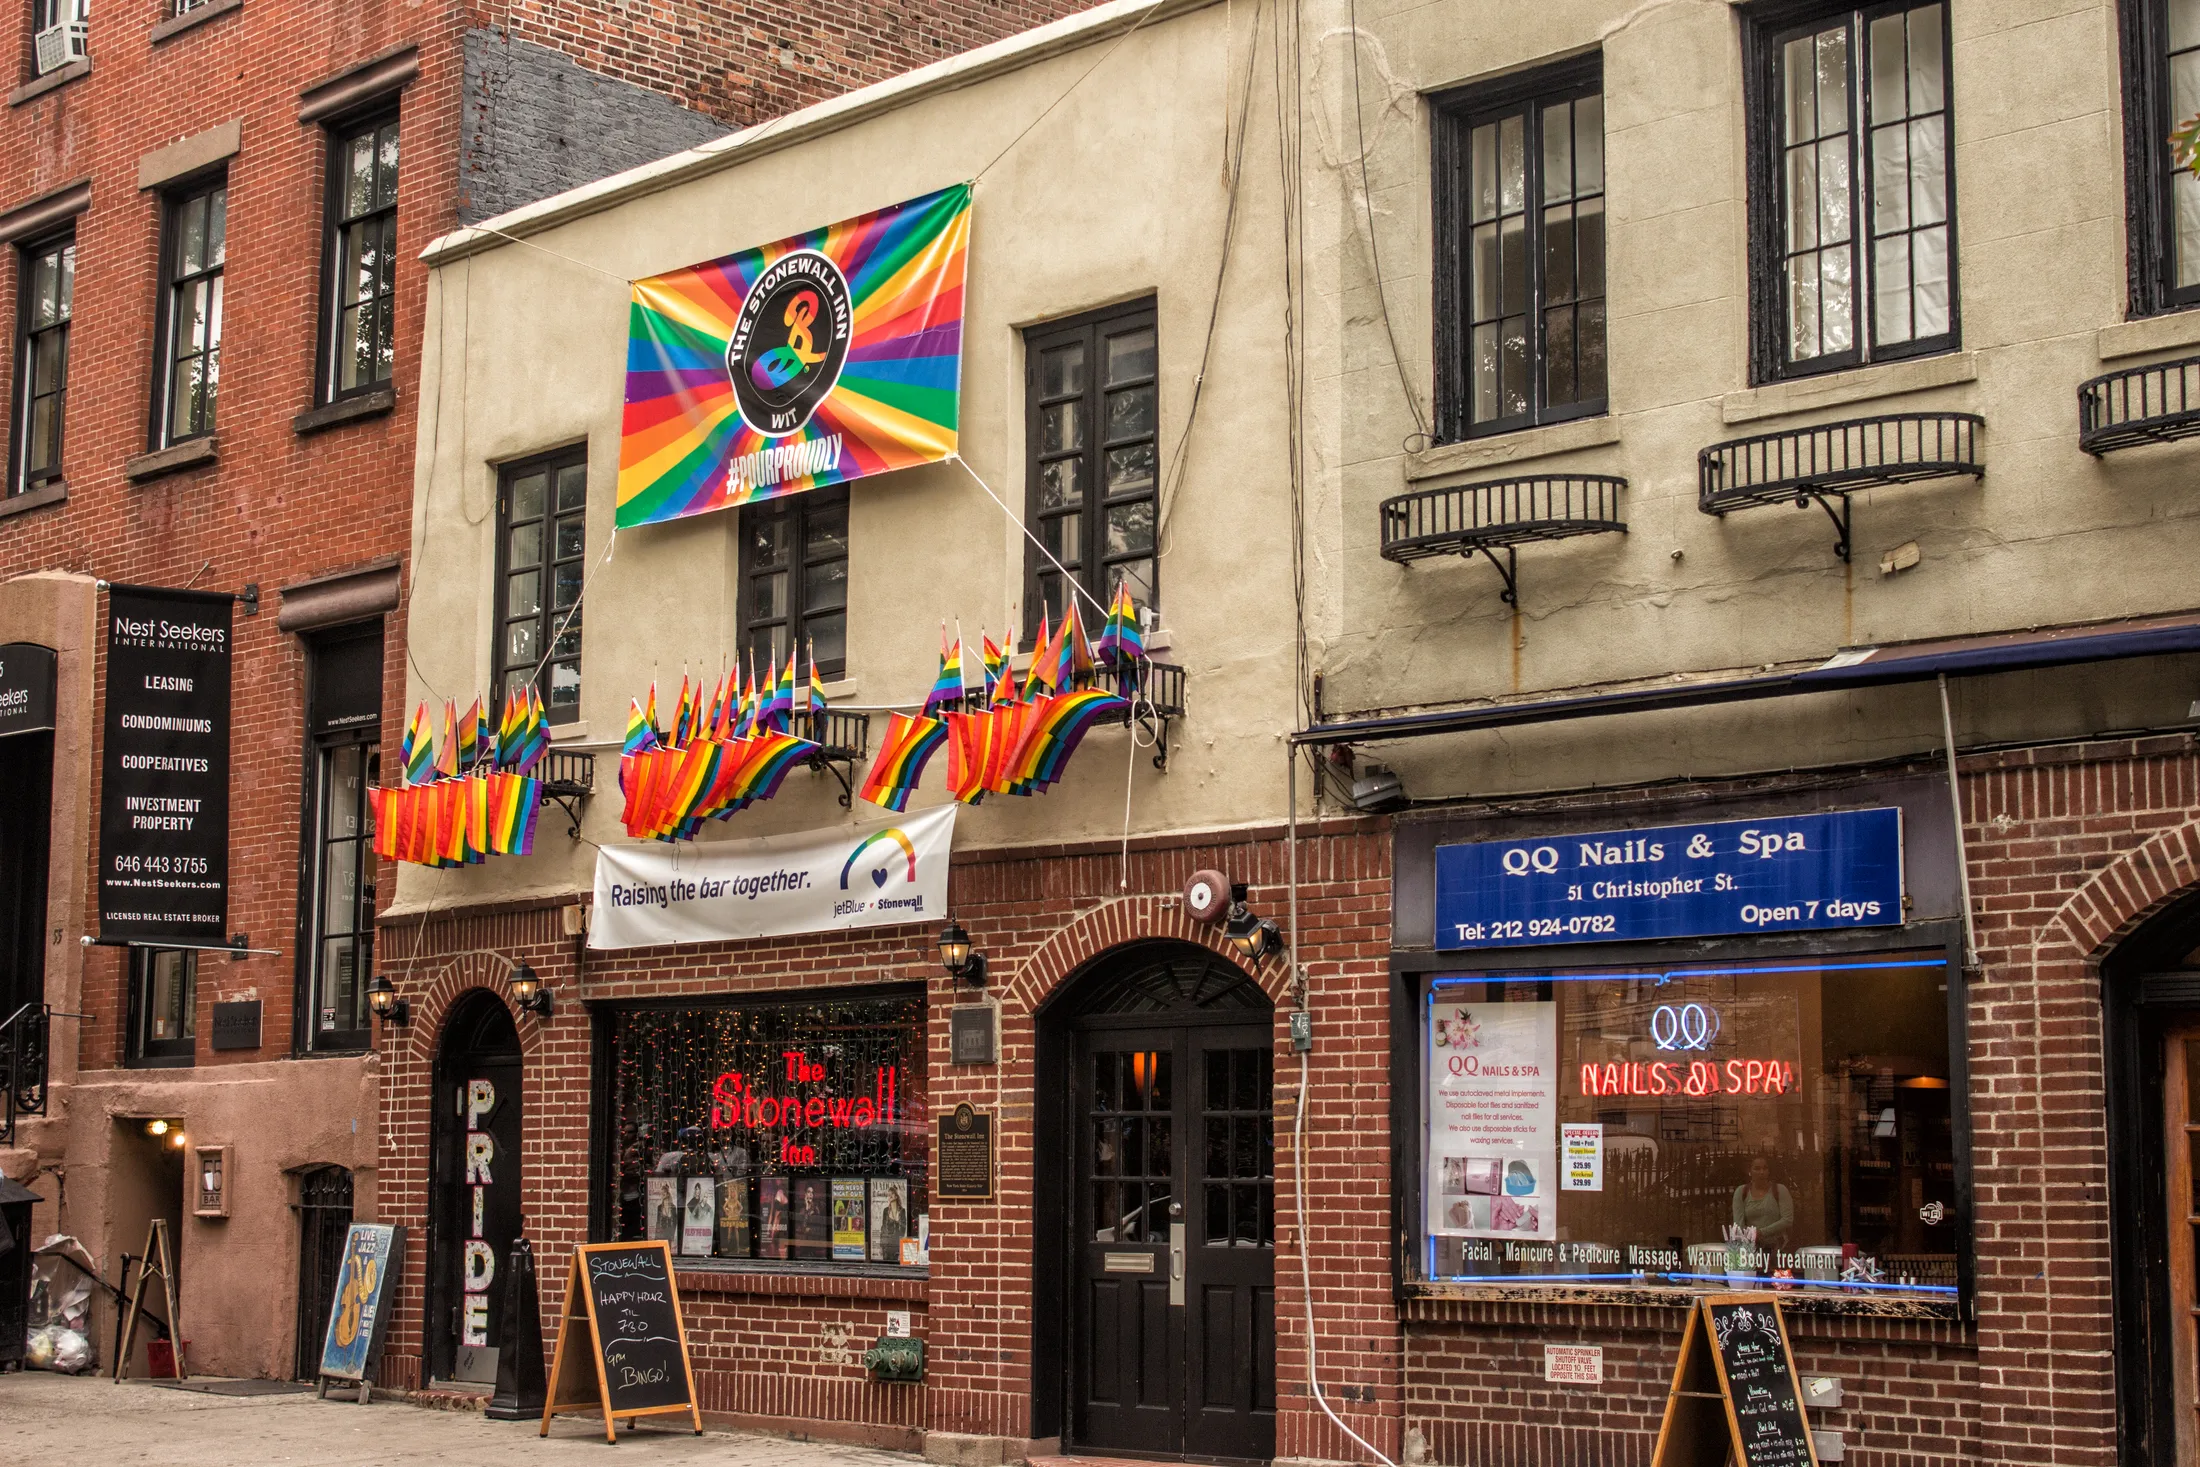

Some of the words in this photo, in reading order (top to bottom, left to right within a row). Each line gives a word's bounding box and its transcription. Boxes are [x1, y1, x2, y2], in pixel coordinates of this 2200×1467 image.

[731, 318, 752, 367] THE
[749, 258, 836, 315] STONEWALL
[833, 294, 848, 340] INN
[771, 407, 797, 429] WIT
[726, 432, 843, 495] #POURPROUDLY
[116, 617, 155, 637] Nest
[160, 620, 225, 642] Seekers
[115, 637, 224, 653] INTERNATIONAL
[145, 675, 193, 692] LEASING
[122, 714, 212, 733] CONDOMINIUMS
[327, 713, 378, 726] www.NestSeekers.com
[122, 755, 208, 772] COOPERATIVES
[127, 796, 201, 813] INVESTMENT
[133, 815, 193, 831] PROPERTY
[1502, 845, 1560, 876] QQ
[1579, 837, 1665, 868] Nails
[1685, 832, 1715, 860] &
[1737, 828, 1806, 860] Spa
[115, 855, 140, 872] 646
[144, 856, 169, 873] 443
[174, 857, 207, 874] 3755
[106, 879, 220, 889] www.NestSeekers.com
[611, 881, 667, 909] Raising
[670, 878, 696, 902] the
[700, 877, 730, 899] bar
[732, 869, 811, 900] together.
[1567, 884, 1583, 902] 51
[1591, 876, 1703, 901] Christopher
[1713, 873, 1739, 893] St.
[833, 899, 865, 918] jetBlue
[878, 894, 923, 910] Stonewall
[1740, 903, 1800, 928] Open
[1805, 900, 1820, 920] 7
[1825, 898, 1882, 922] days
[106, 912, 141, 921] LICENSED
[143, 913, 161, 921] REAL
[164, 913, 190, 922] ESTATE
[192, 914, 220, 922] BROKER
[52, 929, 64, 945] 55
[1456, 922, 1486, 941] Tel:
[1490, 919, 1523, 940] 212
[1528, 914, 1615, 937] 924-0782
[782, 1052, 825, 1082] The
[1448, 1055, 1479, 1077] QQ
[1482, 1066, 1510, 1077] NAILS
[1511, 1066, 1519, 1076] &
[1521, 1066, 1540, 1077] SPA
[1581, 1060, 1667, 1097] NAILS
[1686, 1060, 1709, 1096] &
[1726, 1059, 1787, 1096] SPA
[711, 1066, 895, 1130] Stonewall
[1445, 1101, 1476, 1109] Disposable
[1477, 1101, 1489, 1109] foot
[1490, 1101, 1500, 1109] files
[1501, 1101, 1513, 1109] and
[1482, 1125, 1512, 1133] disposable
[781, 1136, 815, 1166] Inn
[204, 1196, 220, 1204] BAR
[462, 1078, 496, 1348] PRIDE
[360, 1229, 376, 1241] LIVE
[358, 1241, 376, 1253] JAZZ
[590, 1253, 662, 1274] STONEWALL
[1462, 1241, 1493, 1261] Facial
[1506, 1242, 1554, 1262] Manicure
[1559, 1243, 1567, 1263] &
[1572, 1243, 1620, 1264] Pedicure
[1629, 1244, 1682, 1269] Massage,
[1739, 1247, 1770, 1273] Body
[1777, 1249, 1837, 1270] treatment
[600, 1290, 635, 1307] HAPPY
[637, 1291, 667, 1304] HOUR
[617, 1320, 649, 1334] 730
[1574, 1348, 1600, 1357] SPRINKLER
[618, 1360, 670, 1390] BINGO!
[1550, 1371, 1573, 1379] OPPOSITE
[1574, 1372, 1585, 1380] THIS
